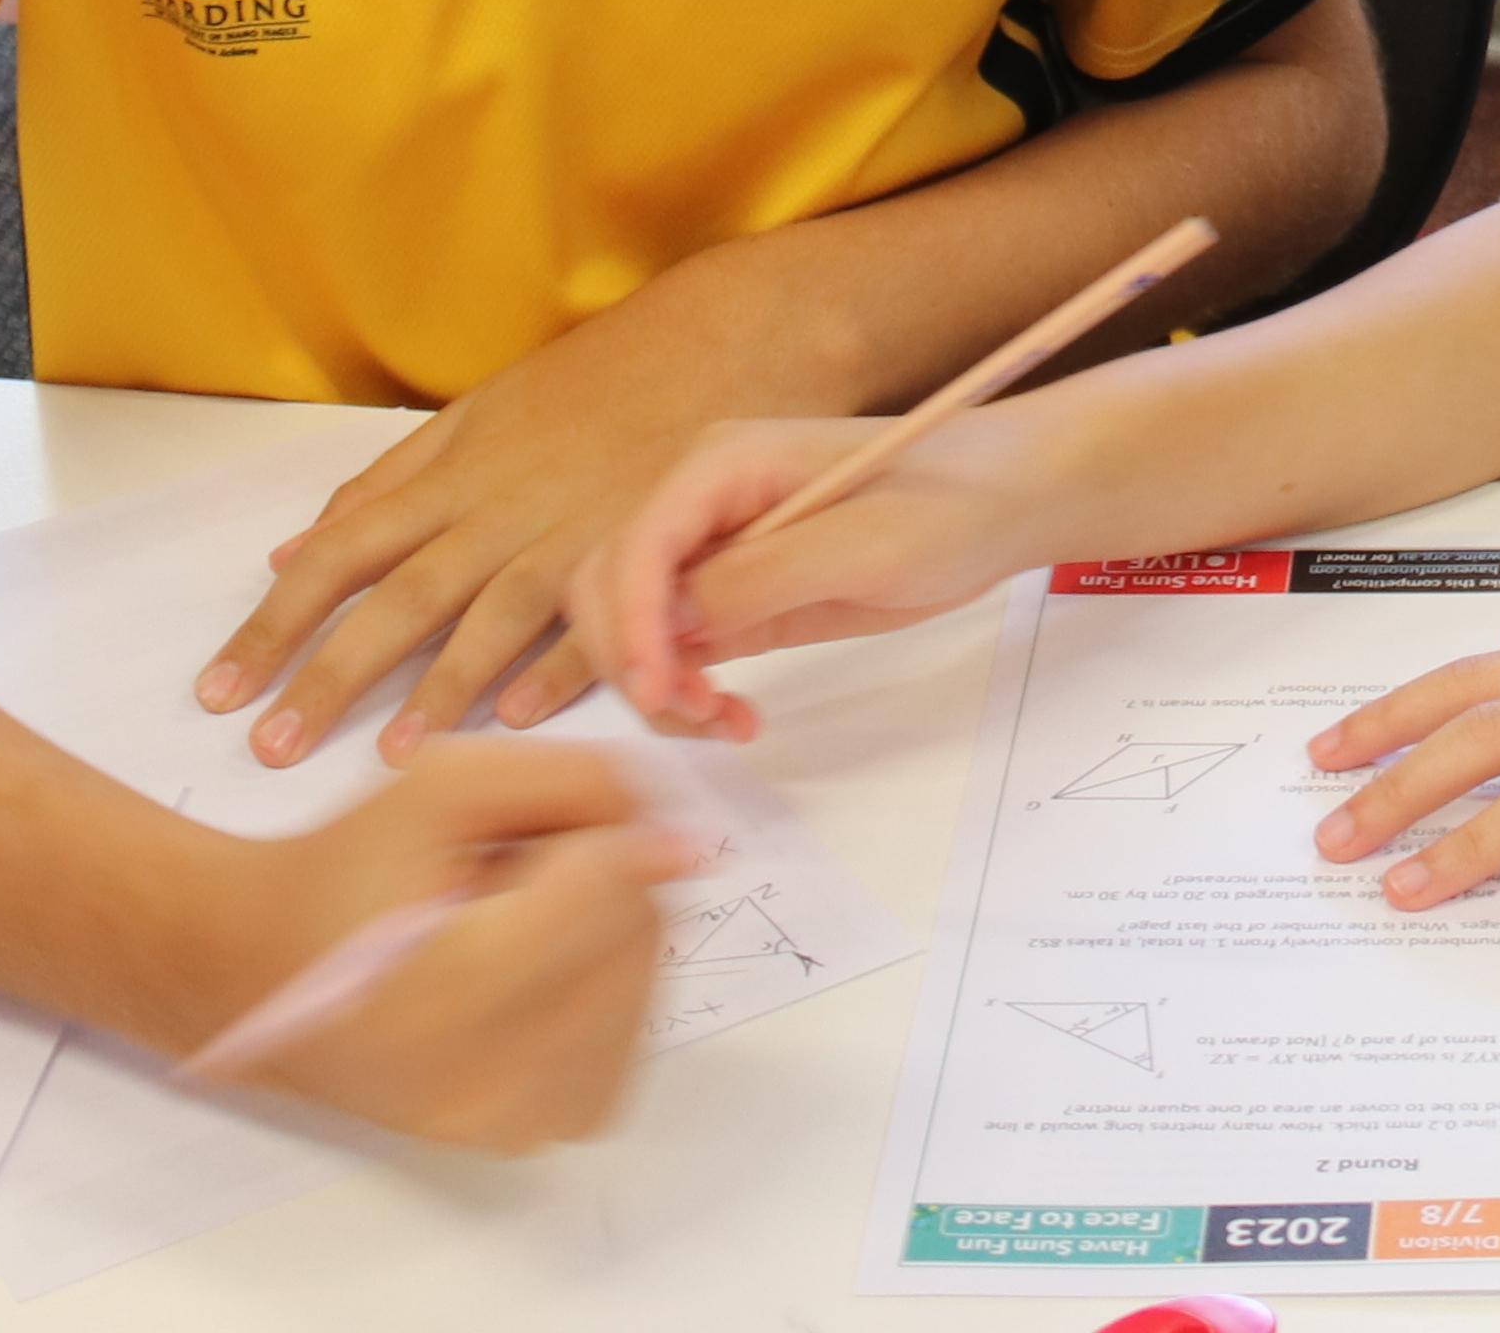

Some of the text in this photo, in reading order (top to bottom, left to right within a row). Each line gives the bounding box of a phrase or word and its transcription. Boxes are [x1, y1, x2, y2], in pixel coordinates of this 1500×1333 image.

[1370, 554, 1394, 563] for
[1080, 576, 1257, 588] Have Sum Fun
[1331, 572, 1443, 588] competition?
[1445, 579, 1475, 588] this
[1268, 685, 1389, 696] could choose?
[1163, 876, 1258, 885] increased?
[1264, 876, 1308, 885] been
[1234, 889, 1312, 900] enlarged
[1117, 921, 1171, 932] page?
[1177, 923, 1207, 932] last
[1213, 923, 1242, 932] the
[1246, 923, 1266, 932] of
[1271, 923, 1342, 932] number
[1348, 923, 1376, 931] the
[1401, 922, 1448, 931] What
[1028, 939, 1062, 948] 852
[1067, 938, 1113, 947] takes
[1138, 938, 1183, 947] total,
[1233, 939, 1276, 948] from
[1281, 937, 1404, 947] consecutively
[1196, 1037, 1215, 1046] to
[1222, 1037, 1280, 1046] drawn
[1361, 1037, 1395, 1047] and
[1418, 1036, 1437, 1047] of
[1443, 1036, 1496, 1044] terms
[1303, 1054, 1342, 1063] with
[1350, 1053, 1435, 1063] isosceles,
[1441, 1053, 1455, 1062] is
[1063, 1105, 1132, 1115] metre?
[1138, 1104, 1201, 1113] square
[1206, 1105, 1242, 1113] one
[1247, 1105, 1267, 1115] of
[1273, 1105, 1314, 1113] area
[1320, 1105, 1343, 1113] an
[1349, 1104, 1400, 1112] cover
[1405, 1104, 1425, 1112] to
[1431, 1103, 1454, 1113] be
[1459, 1103, 1479, 1111] to
[984, 1122, 1018, 1132] line
[1024, 1122, 1035, 1130] a
[1040, 1122, 1097, 1133] would
[1103, 1120, 1144, 1132] long
[1150, 1122, 1216, 1132] metres
[1222, 1121, 1273, 1130] many
[1279, 1122, 1322, 1131] How
[1331, 1121, 1379, 1131] thick.
[1386, 1121, 1422, 1129] mm
[1428, 1120, 1457, 1130] 0.2
[1462, 1120, 1497, 1128] line
[1317, 1159, 1418, 1172] Round 2
[1418, 1199, 1482, 1226] 7/8
[955, 1209, 1160, 1230] Face to Face
[1227, 1217, 1350, 1245] 2023
[958, 1235, 1151, 1255] Have Sum Fun
[1399, 1236, 1500, 1250] Division
